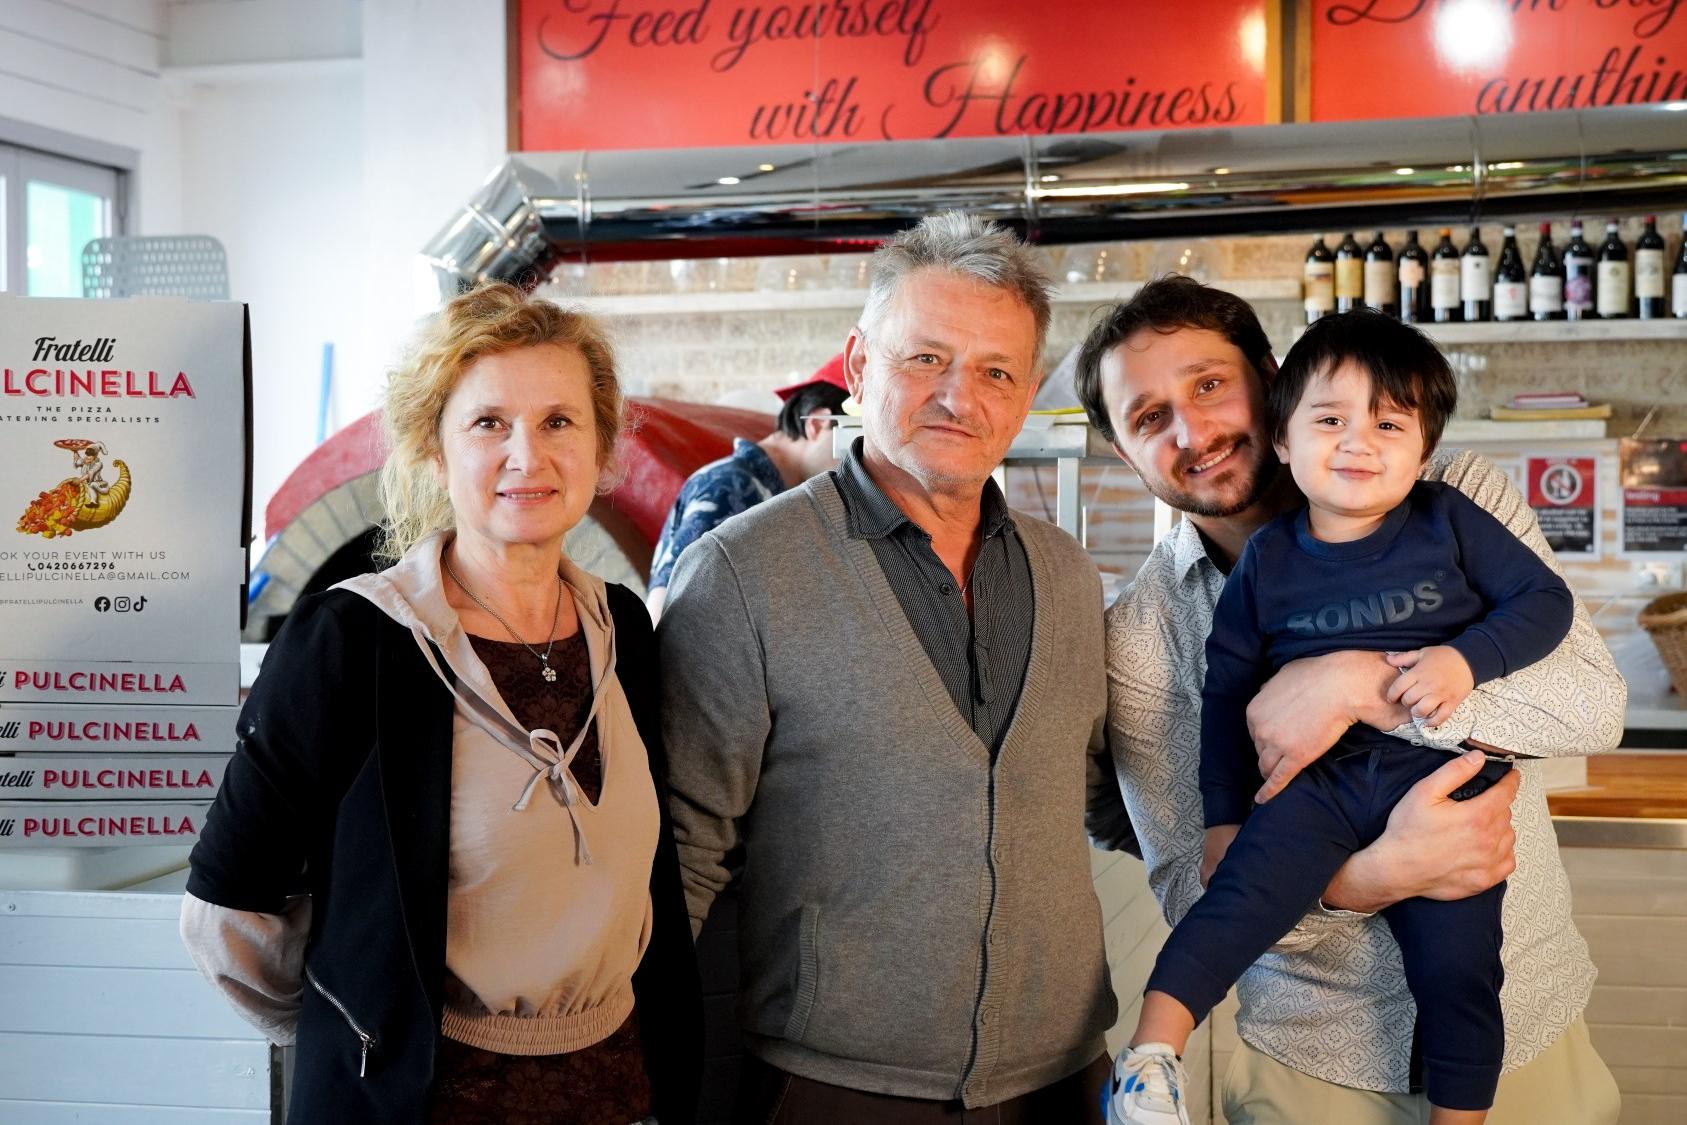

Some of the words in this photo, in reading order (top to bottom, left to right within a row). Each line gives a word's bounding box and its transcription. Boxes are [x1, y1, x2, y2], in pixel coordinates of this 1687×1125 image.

[538, 0, 710, 61] Feed
[711, 0, 941, 72] yourself
[748, 76, 864, 139] with
[882, 55, 1247, 140] Happiness
[32, 336, 117, 362] Fratelli
[23, 551, 59, 560] YOUR
[65, 551, 106, 560] EVENT
[112, 551, 144, 560] WITH
[150, 551, 166, 559] US
[38, 562, 116, 570] 0420667296
[14, 670, 187, 693] PULCINELLA
[28, 720, 200, 741] PULCINELLA
[43, 768, 214, 789] PULCINELLA
[23, 815, 197, 837] PULCINELLA
